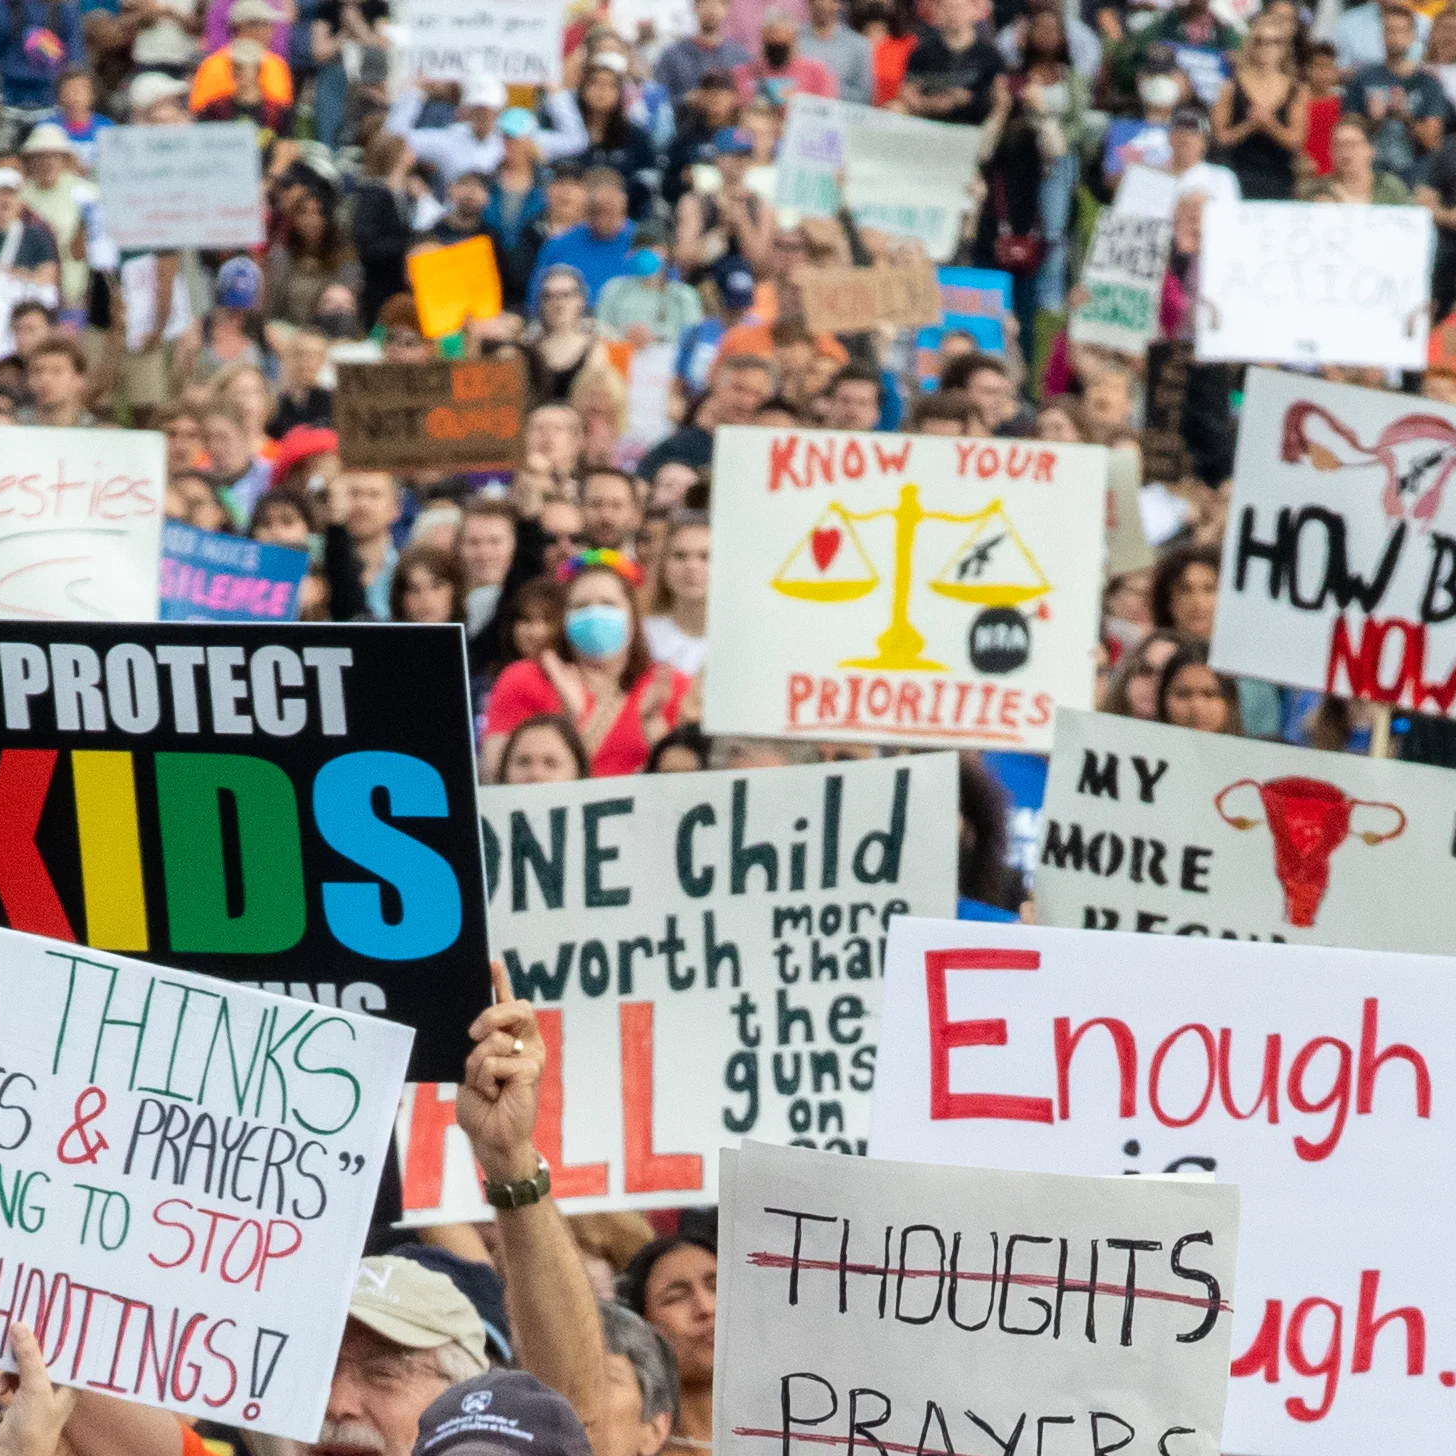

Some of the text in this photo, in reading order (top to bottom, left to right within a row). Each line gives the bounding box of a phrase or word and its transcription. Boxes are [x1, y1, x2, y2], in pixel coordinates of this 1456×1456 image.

[1220, 259, 1418, 311] ACTION
[766, 436, 1058, 493] KNOW YOUR
[785, 672, 1054, 731] PRIORITIES
[1076, 749, 1169, 805] MY
[674, 768, 912, 897] Child
[1040, 819, 1214, 894] MORE
[502, 910, 743, 998] worth
[772, 897, 912, 940] more
[43, 948, 364, 1136] THINKS
[730, 990, 865, 1048] the
[924, 947, 1434, 1161] Enough
[55, 1085, 110, 1165] &
[722, 1043, 877, 1134] guns
[788, 1095, 845, 1133] on
[73, 1183, 131, 1253] TO
[147, 1198, 304, 1294] STOP
[761, 1205, 1224, 1349] THOUGHTS
